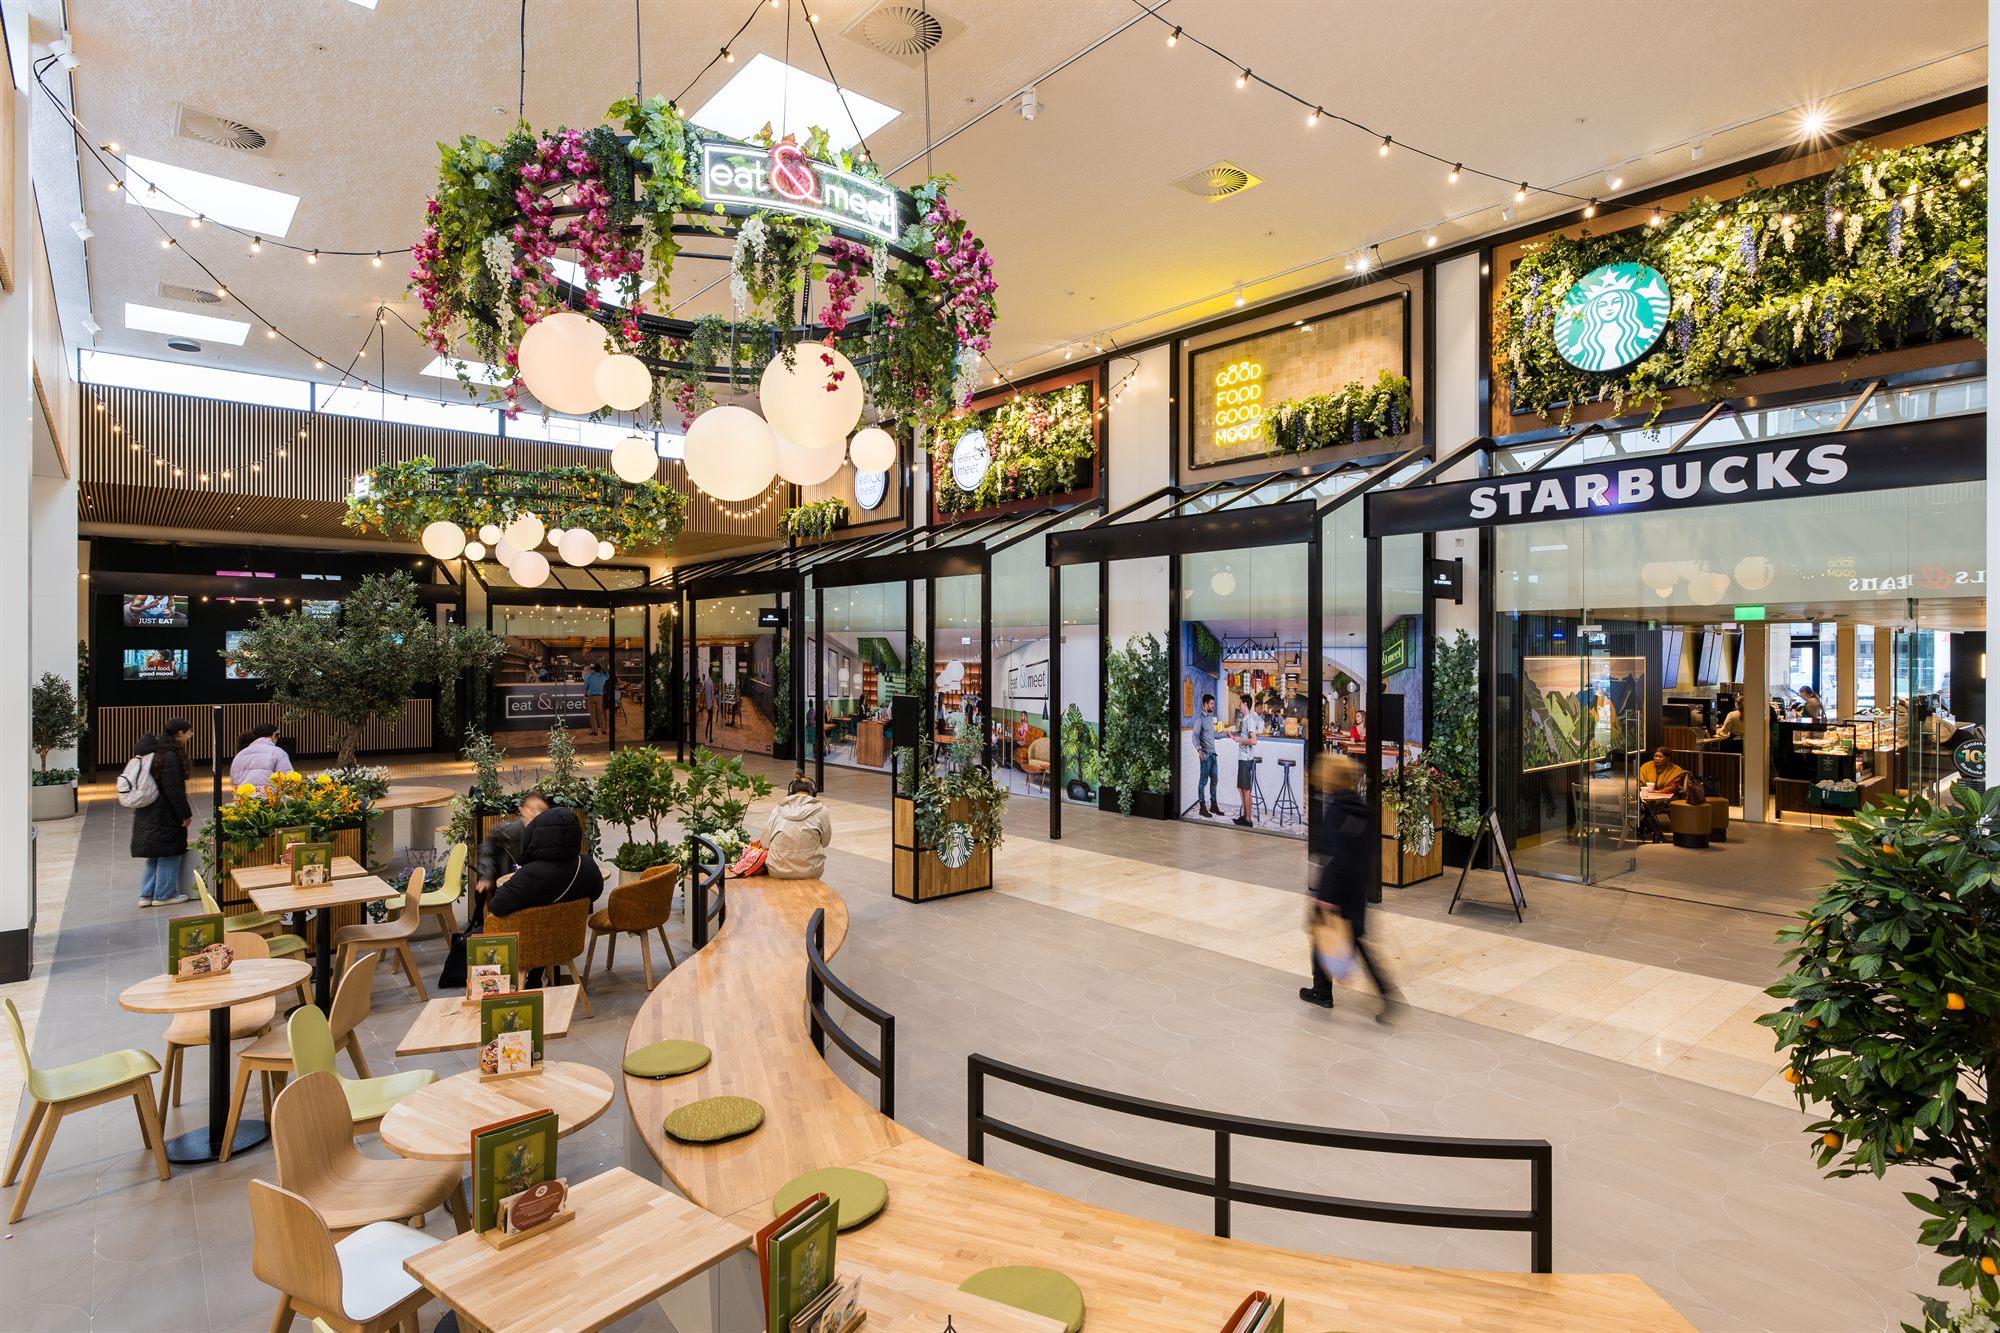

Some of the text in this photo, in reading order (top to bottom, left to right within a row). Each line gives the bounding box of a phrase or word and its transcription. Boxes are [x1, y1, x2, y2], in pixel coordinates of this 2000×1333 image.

[709, 143, 895, 227] eat & meet
[1215, 362, 1262, 388] GOOD
[1216, 384, 1262, 407] FOOD
[1215, 404, 1261, 426] GOOD
[1215, 423, 1262, 445] MOOD
[957, 463, 979, 477] meet
[1468, 443, 1849, 520] STARBUCKS
[138, 617, 158, 625] JUST
[1027, 670, 1046, 689] meet
[511, 700, 532, 711] eat
[537, 692, 554, 710] &
